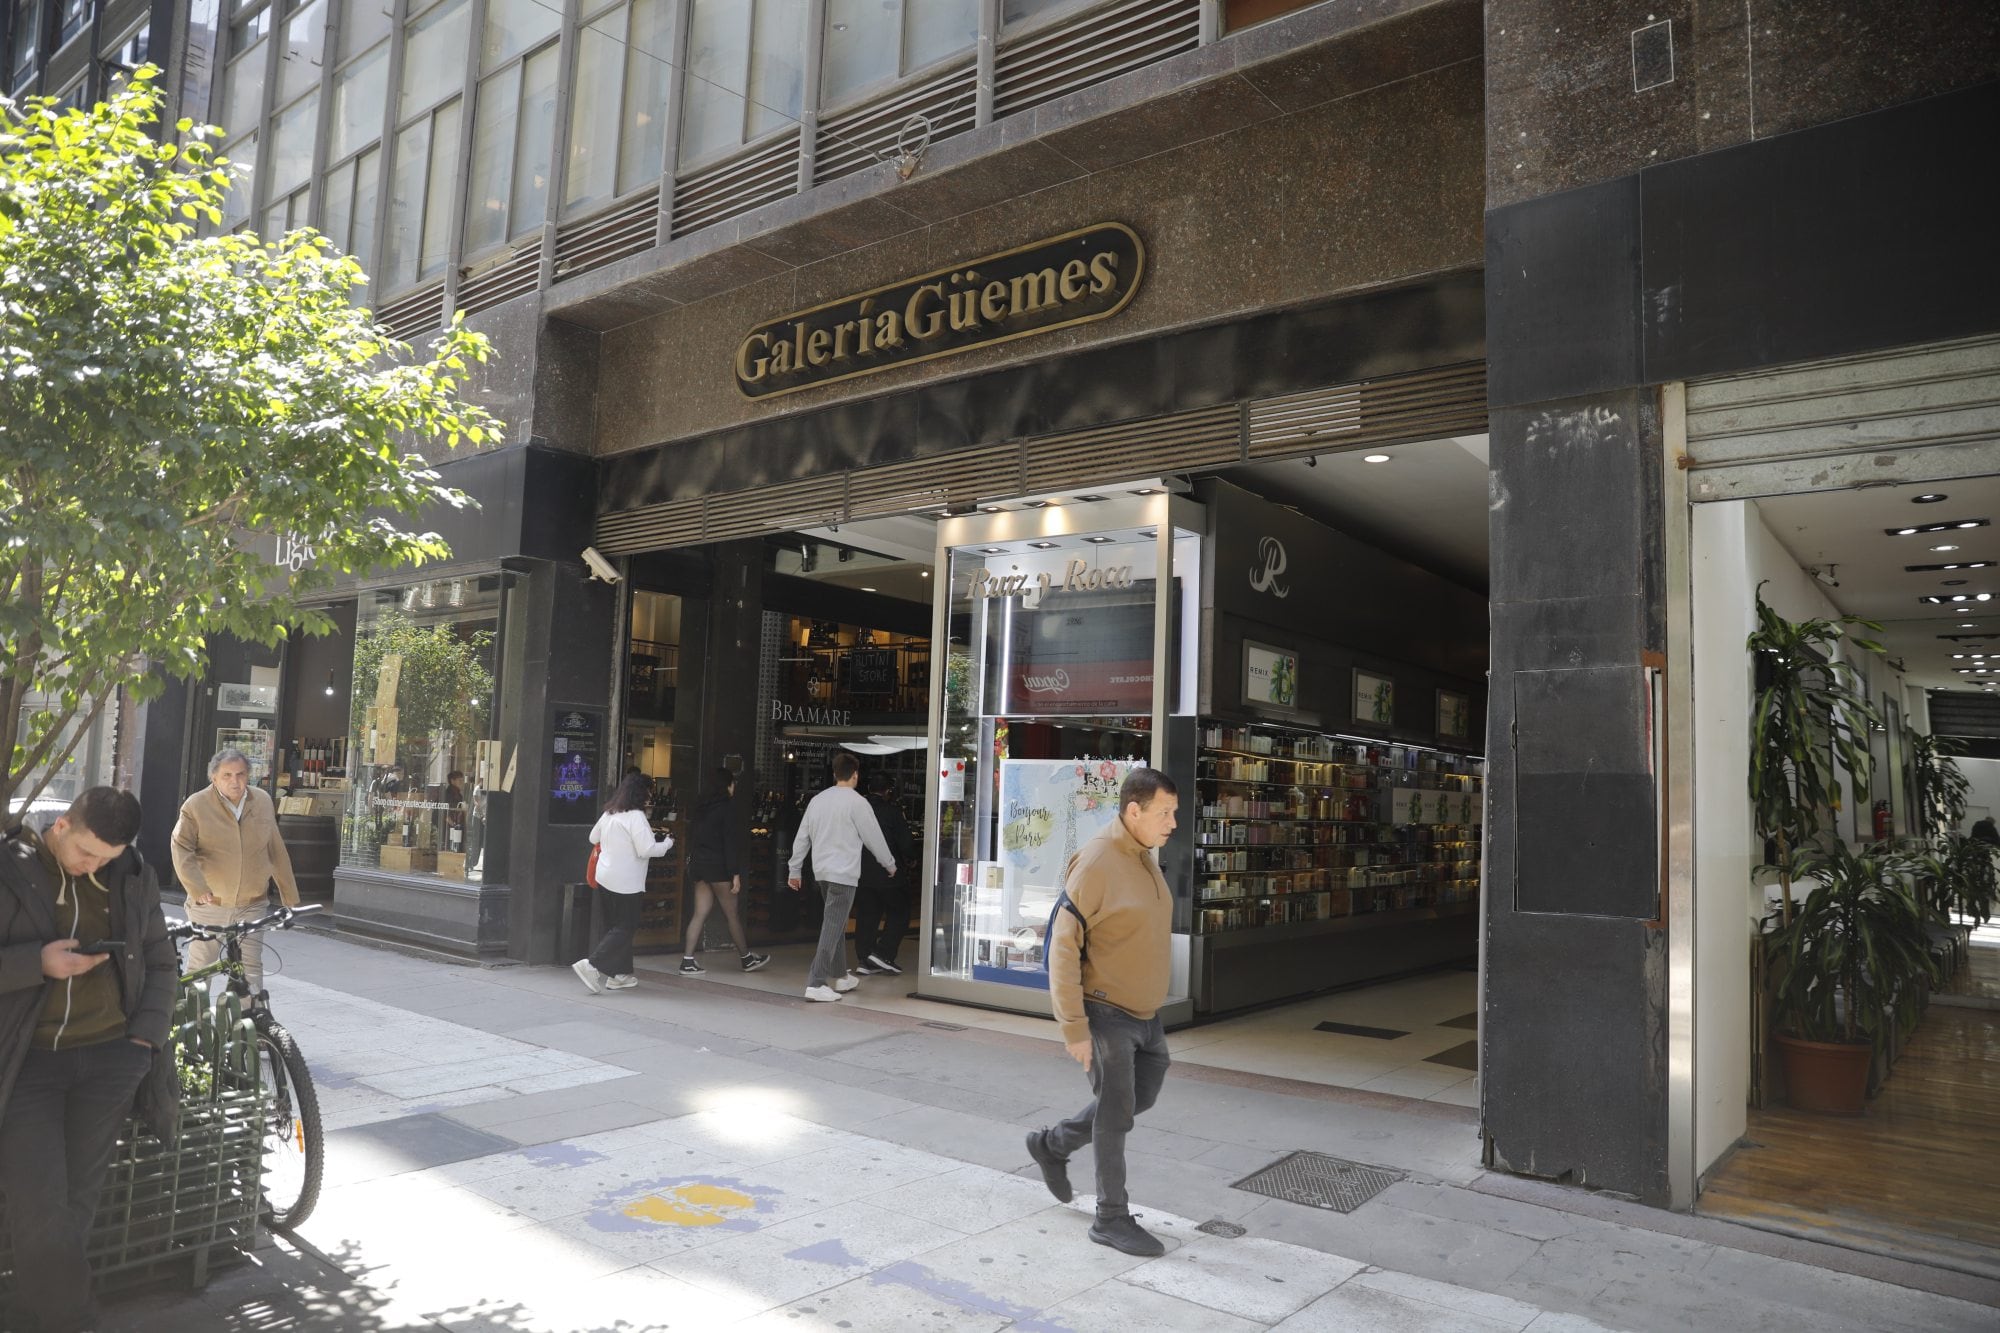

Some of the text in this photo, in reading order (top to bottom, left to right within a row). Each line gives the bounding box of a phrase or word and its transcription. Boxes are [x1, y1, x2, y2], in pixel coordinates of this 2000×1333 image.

[964, 558, 1134, 606] Ruiz y Roca
[859, 668, 888, 683] STORE
[771, 699, 852, 727] BRAMARE
[1010, 801, 1050, 825] Bonjour
[1015, 823, 1042, 847] Paris
